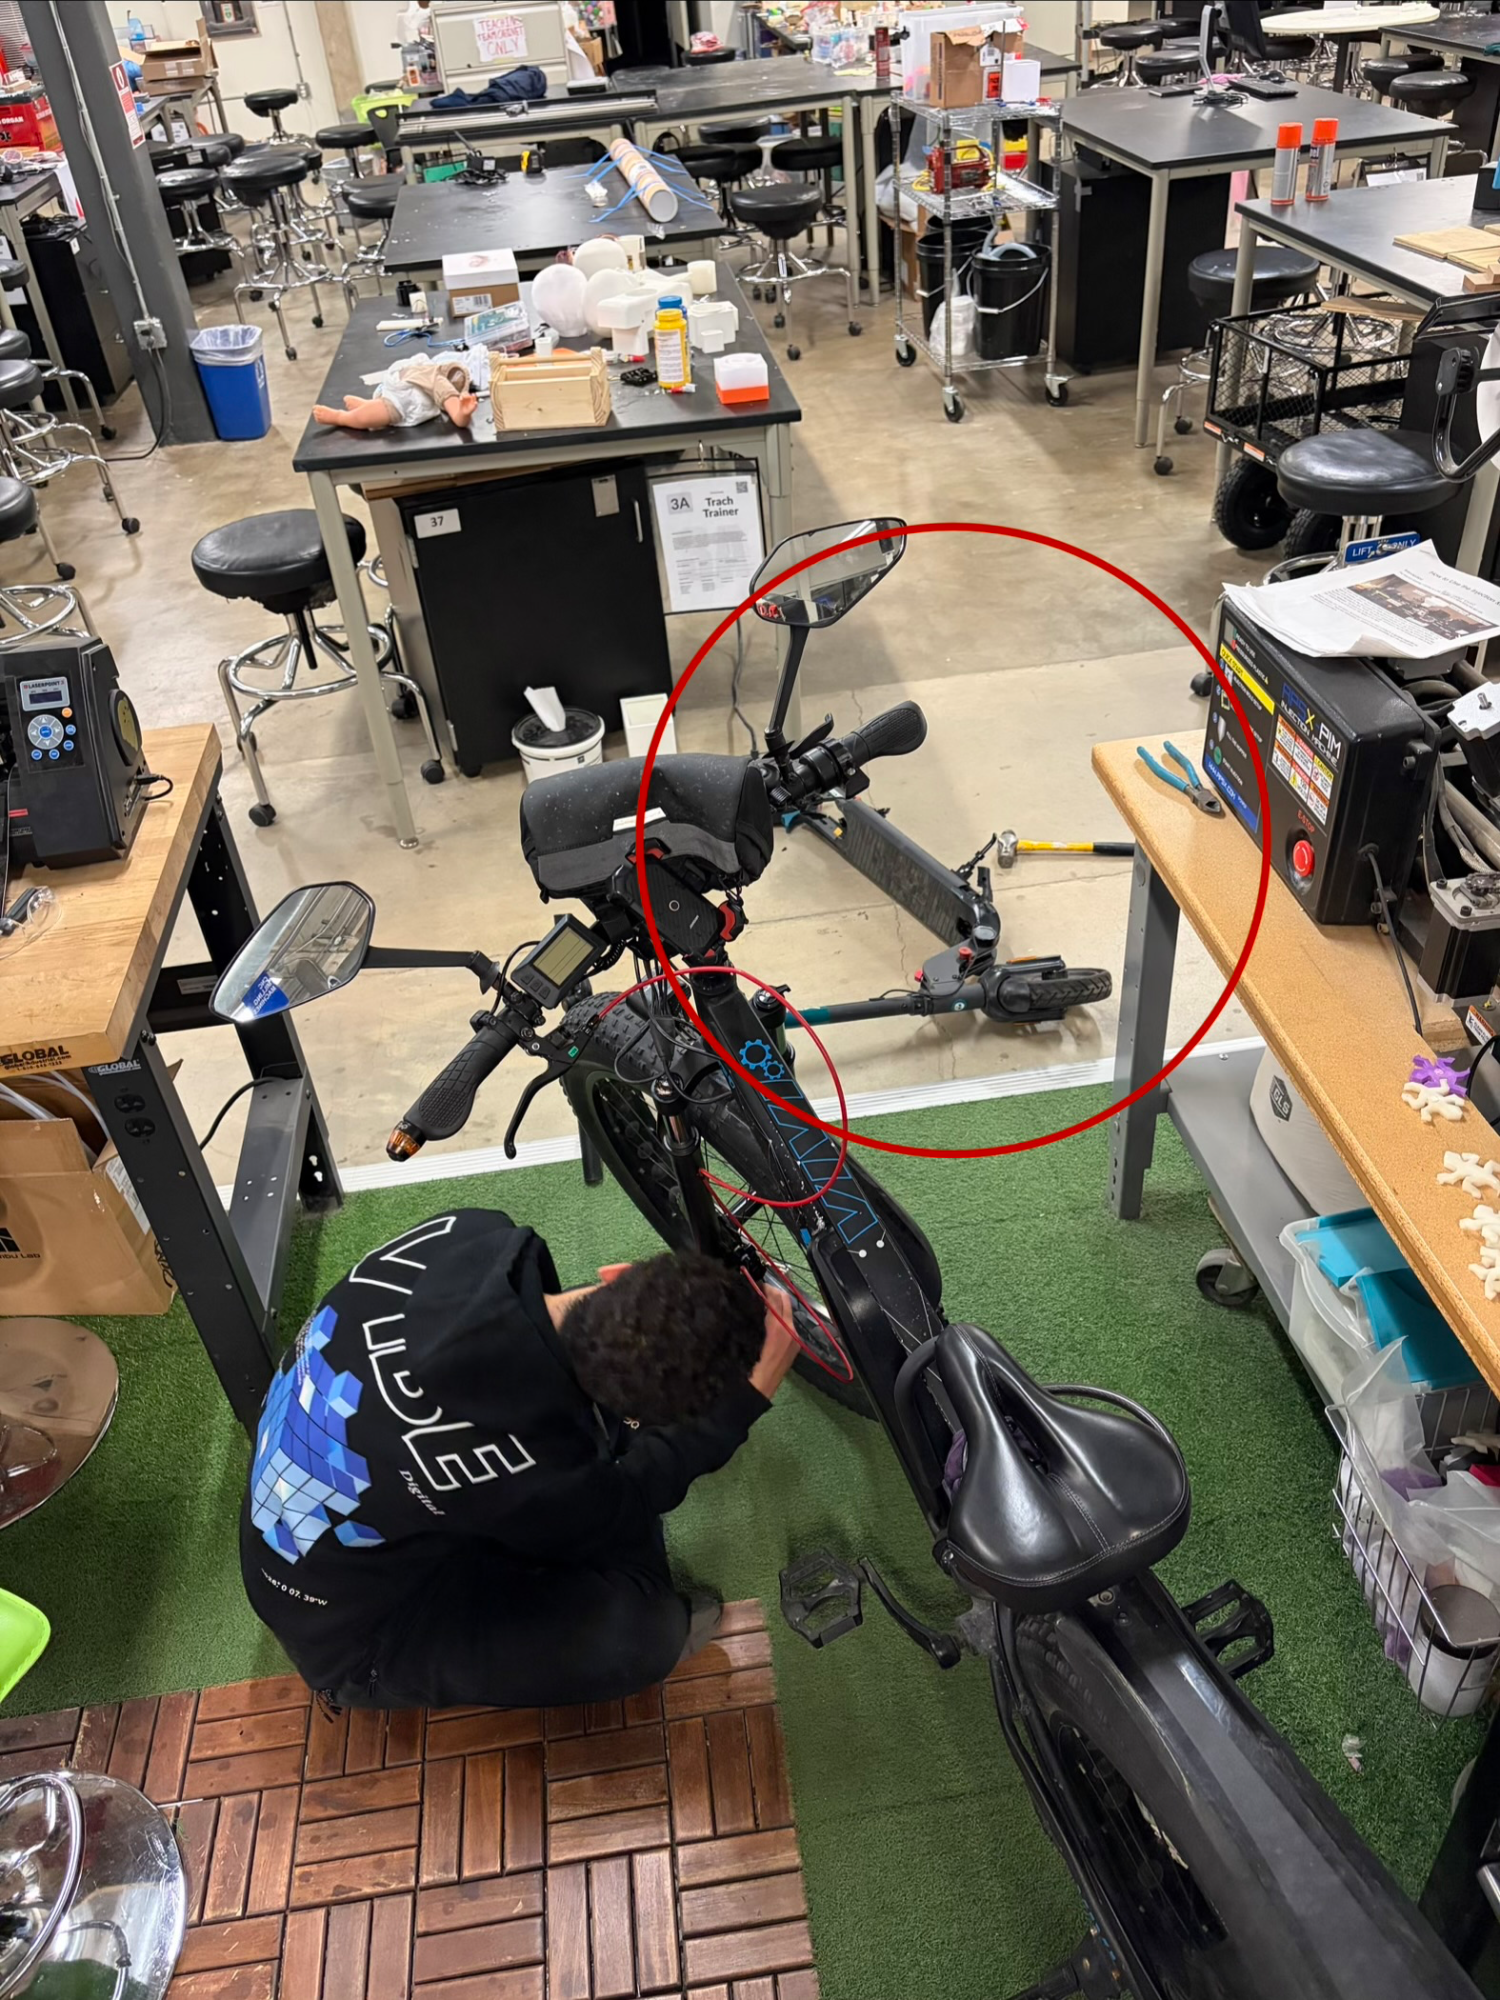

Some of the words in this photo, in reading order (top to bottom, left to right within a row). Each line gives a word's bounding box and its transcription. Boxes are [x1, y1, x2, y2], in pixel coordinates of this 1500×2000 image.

[487, 37, 518, 56] ONLY
[670, 496, 690, 510] 3A
[704, 496, 734, 506] Trach
[702, 508, 739, 518] Trainer
[430, 516, 444, 528] 37
[1352, 546, 1374, 556] LIFT
[28, 680, 60, 689] LASERPOINT
[1280, 699, 1310, 736] INJECTION
[1298, 809, 1316, 833] E-STOP
[0, 1046, 69, 1065] GLOBAL
[98, 1060, 140, 1073] GLOBAL
[398, 1470, 446, 1516] Digital
